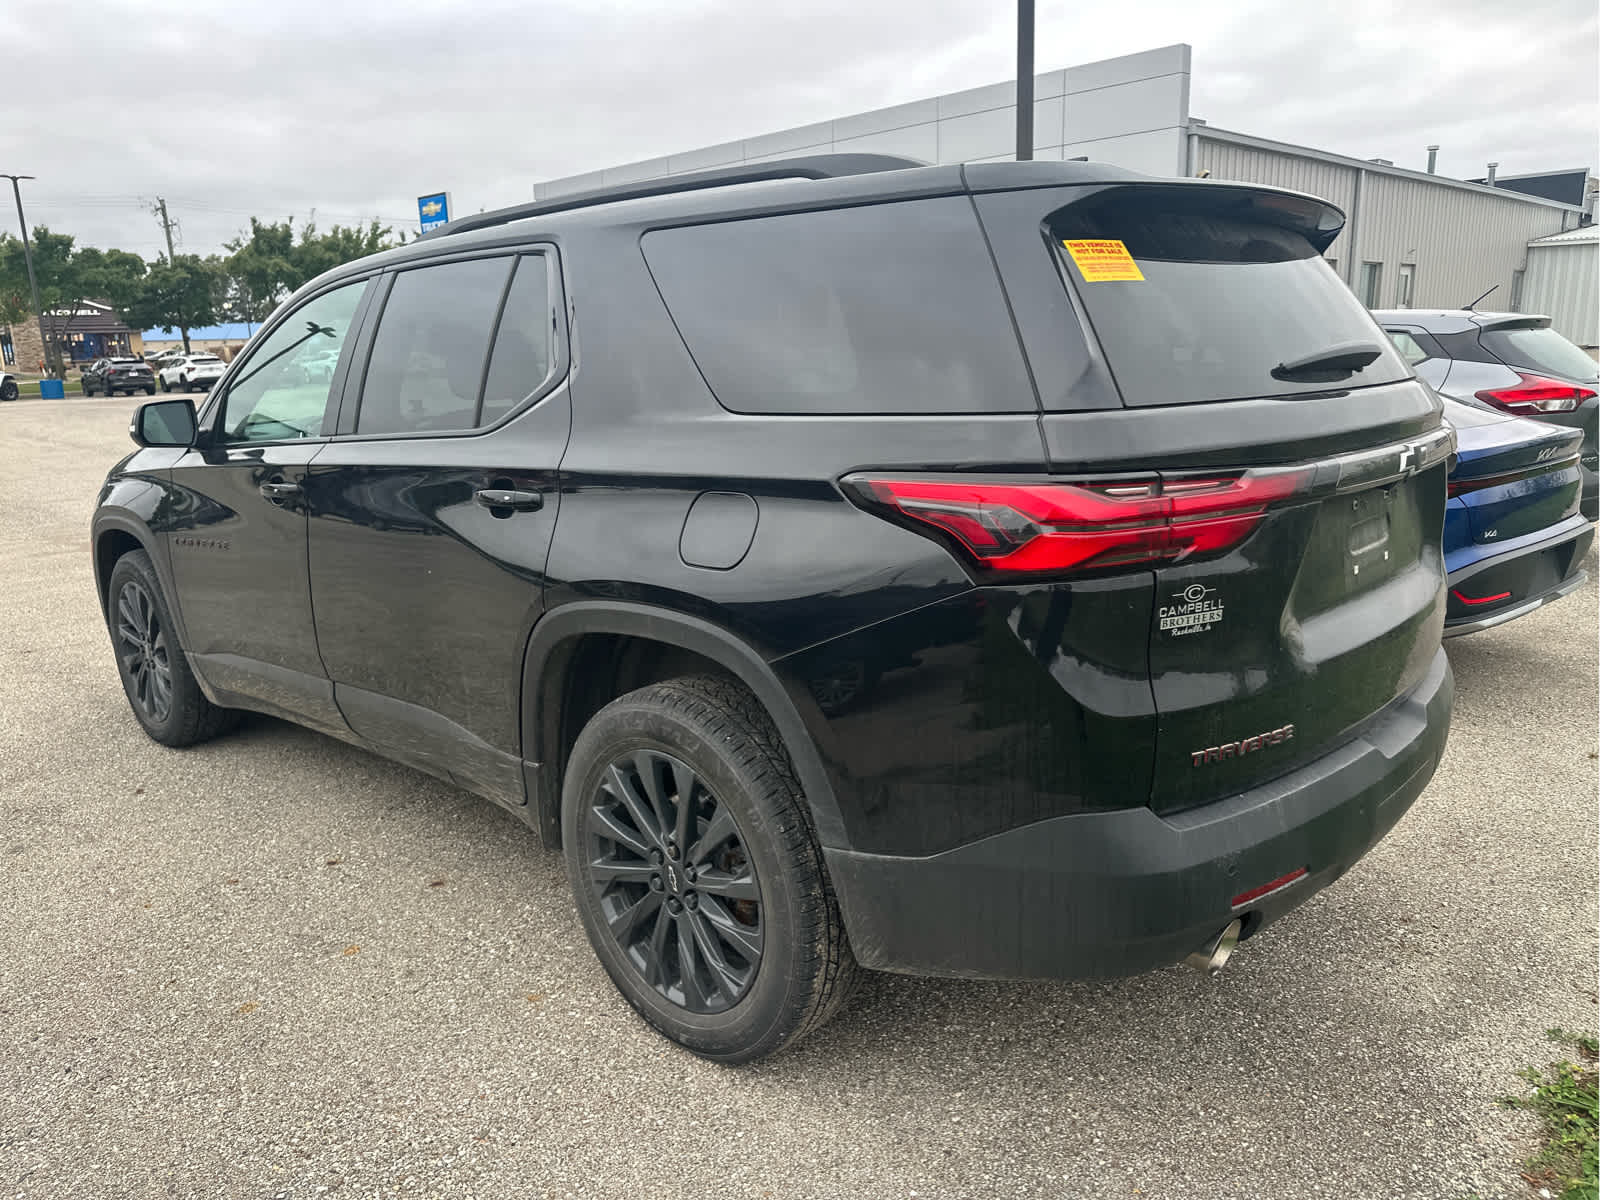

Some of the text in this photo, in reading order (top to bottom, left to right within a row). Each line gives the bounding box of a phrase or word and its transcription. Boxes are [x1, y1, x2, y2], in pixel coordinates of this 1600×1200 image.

[1160, 599, 1224, 617] CAMPBELL
[1161, 611, 1222, 629] BROTHERS
[1191, 724, 1294, 767] TRAVERSE
